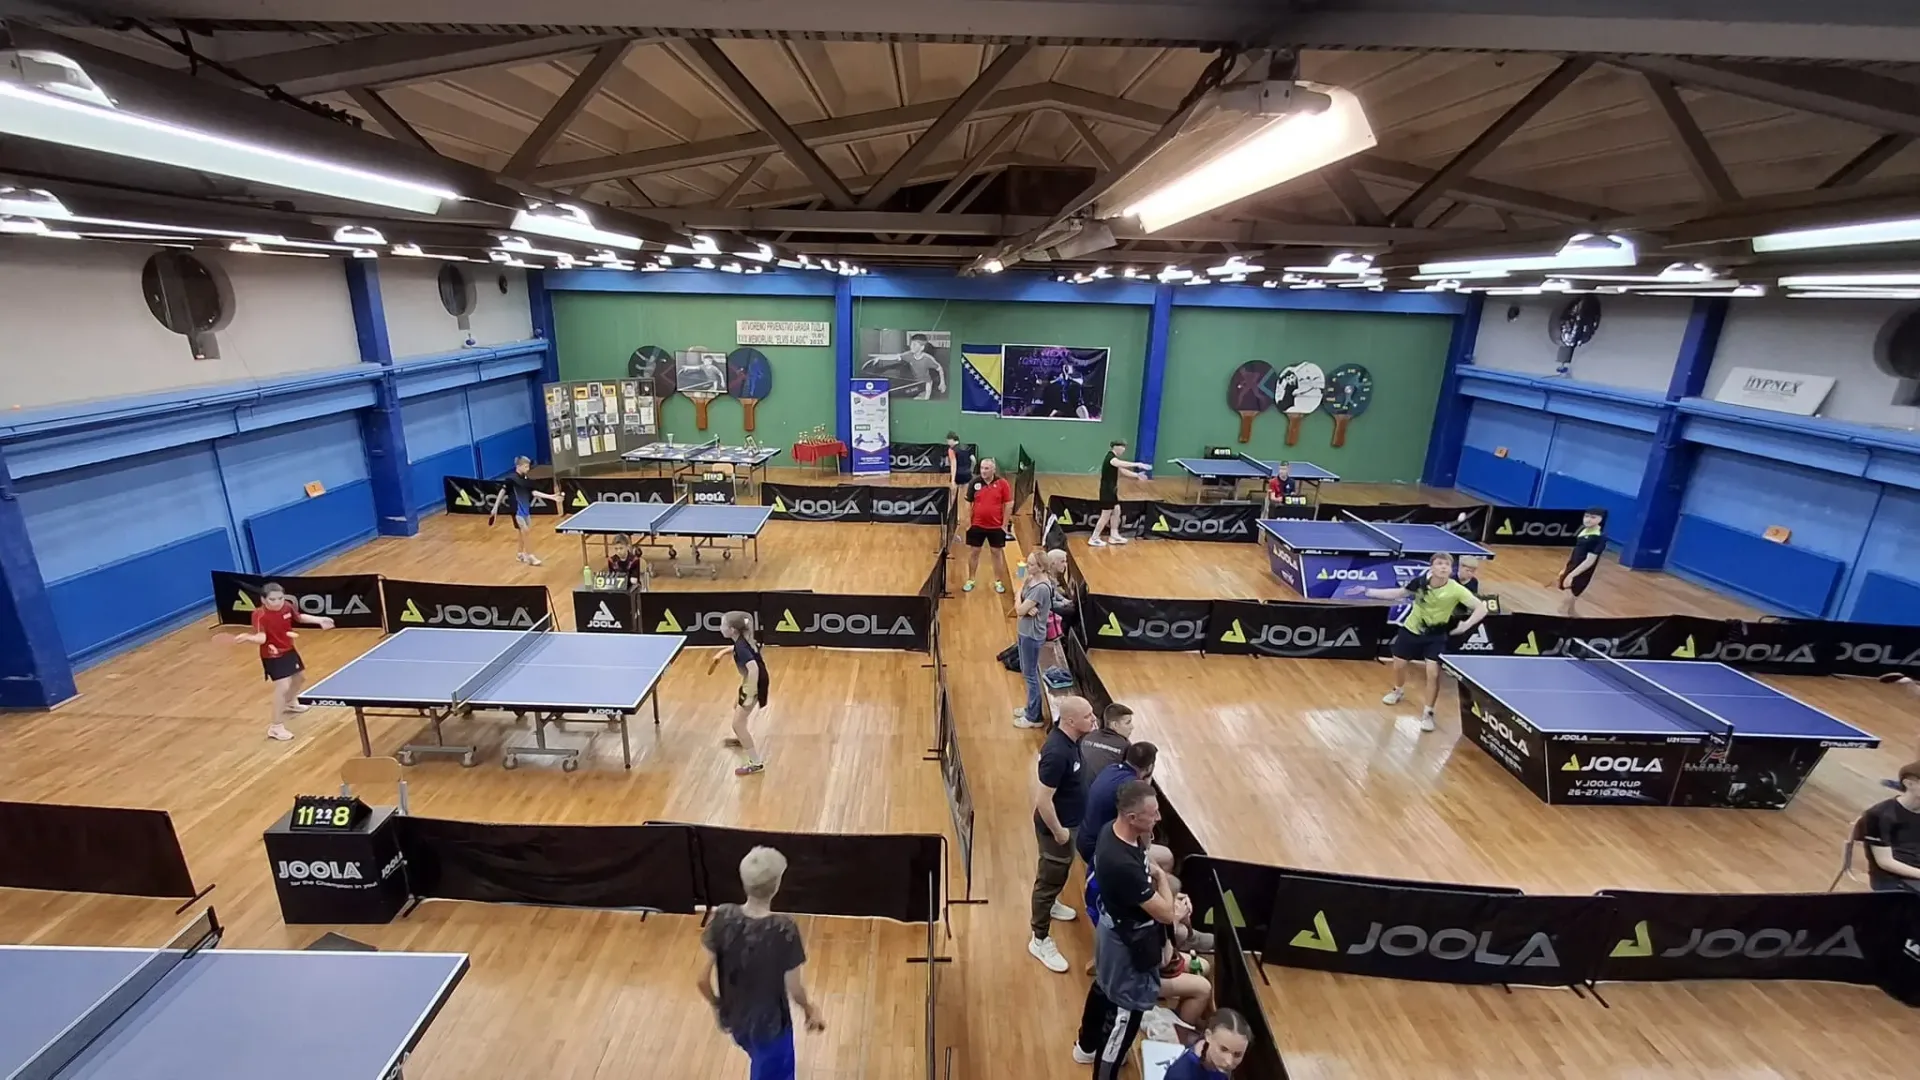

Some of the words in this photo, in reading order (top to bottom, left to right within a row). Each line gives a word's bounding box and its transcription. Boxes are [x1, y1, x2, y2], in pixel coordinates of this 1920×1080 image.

[695, 492, 725, 501] JOOLA
[789, 499, 860, 515] JOOLA
[870, 499, 939, 516] JOOLA
[1171, 519, 1248, 534] JOOLA
[1327, 570, 1378, 580] JOOLA
[428, 605, 535, 626] JOOLA
[587, 620, 622, 628] JOOLA
[804, 613, 915, 636] JOOLA
[1250, 624, 1361, 647] JOOLA
[1700, 642, 1815, 663] JOOLA
[1481, 711, 1531, 757] JOOLA
[1581, 756, 1663, 772] JOOLA
[1619, 780, 1641, 788] KUP
[298, 806, 315, 825] 11
[333, 806, 350, 826] 8
[278, 860, 363, 879] JOOLA
[315, 880, 353, 889] Champion
[1347, 922, 1560, 968] JOOLA
[1660, 925, 1865, 960] JOOLA
